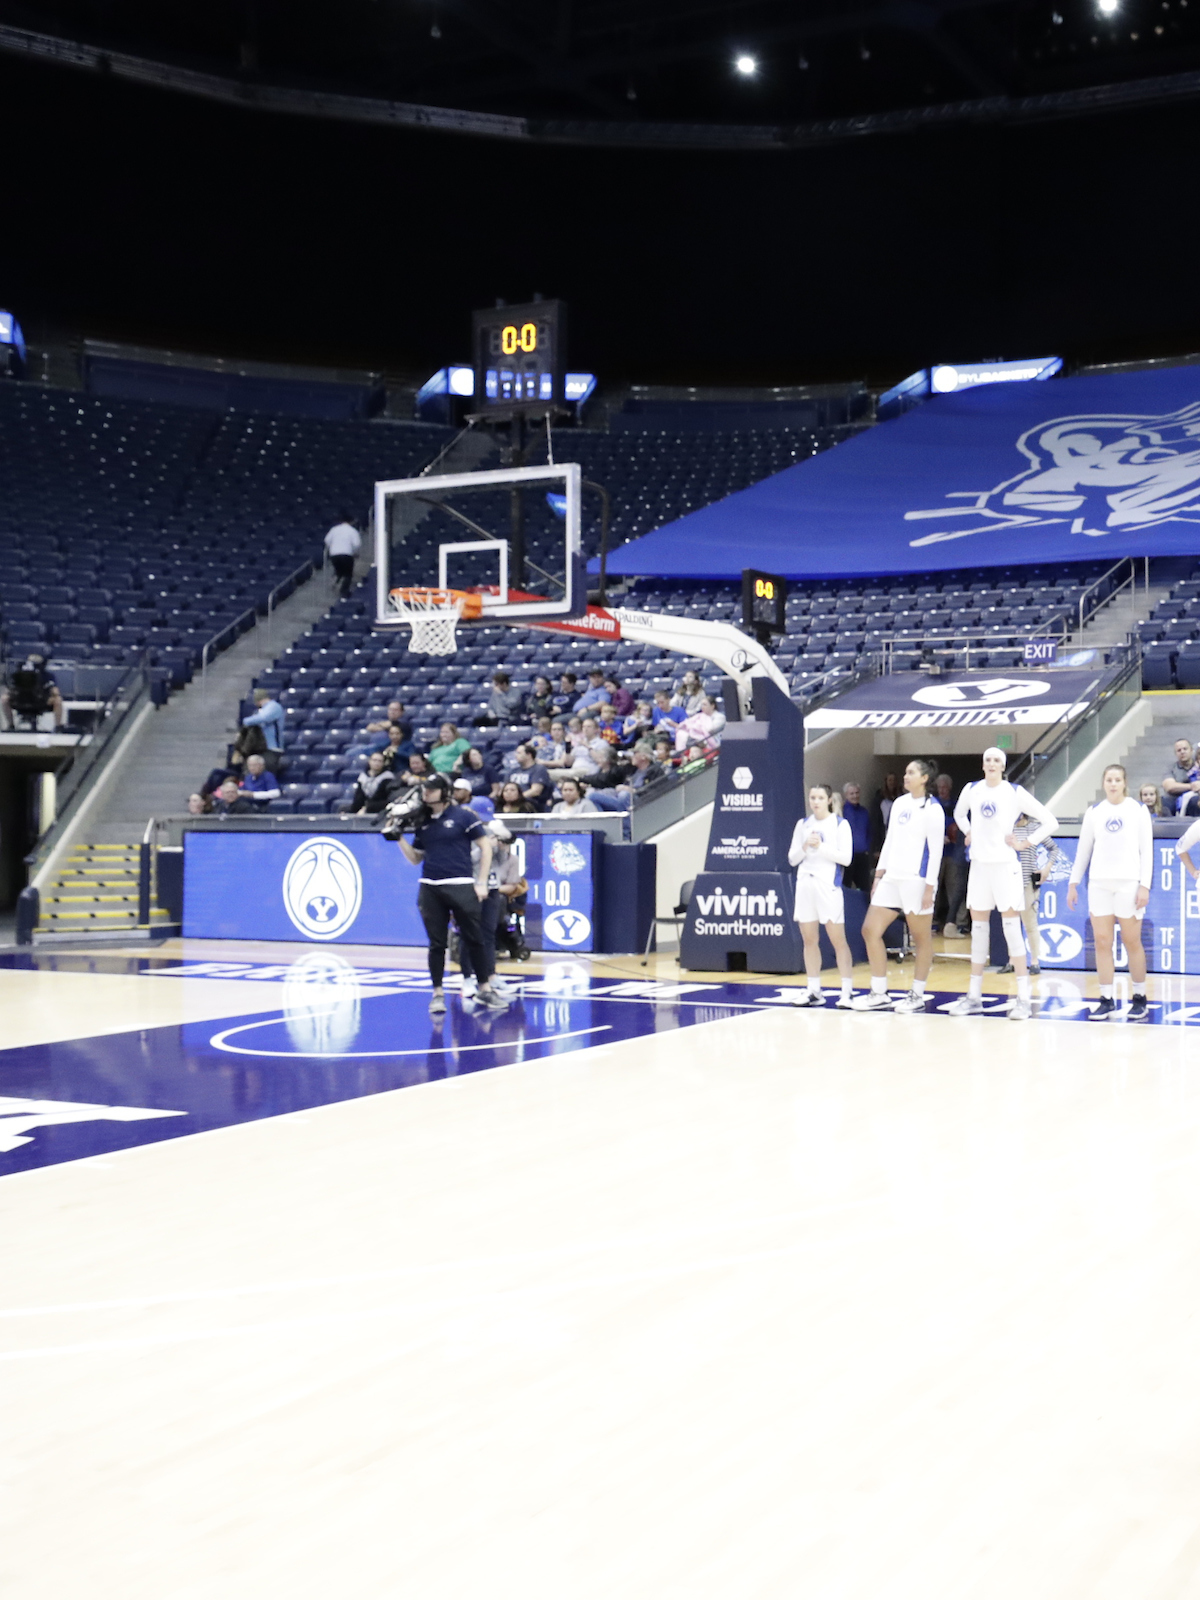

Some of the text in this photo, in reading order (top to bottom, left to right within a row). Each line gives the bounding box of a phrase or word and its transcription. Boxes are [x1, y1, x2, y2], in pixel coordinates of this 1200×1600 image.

[502, 323, 536, 354] 0.0
[1024, 643, 1056, 660] EXIT
[946, 683, 1031, 702] Y
[852, 709, 1030, 727] GO COUGS
[722, 794, 763, 806] VISIBLE
[711, 846, 769, 855] AMERICA FIRST
[1160, 848, 1175, 866] TF
[545, 880, 570, 906] 0.0
[696, 887, 783, 916] vivint.
[309, 896, 336, 921] Y
[553, 915, 582, 940] Y
[1160, 927, 1175, 946] TF
[1039, 928, 1073, 957] Y
